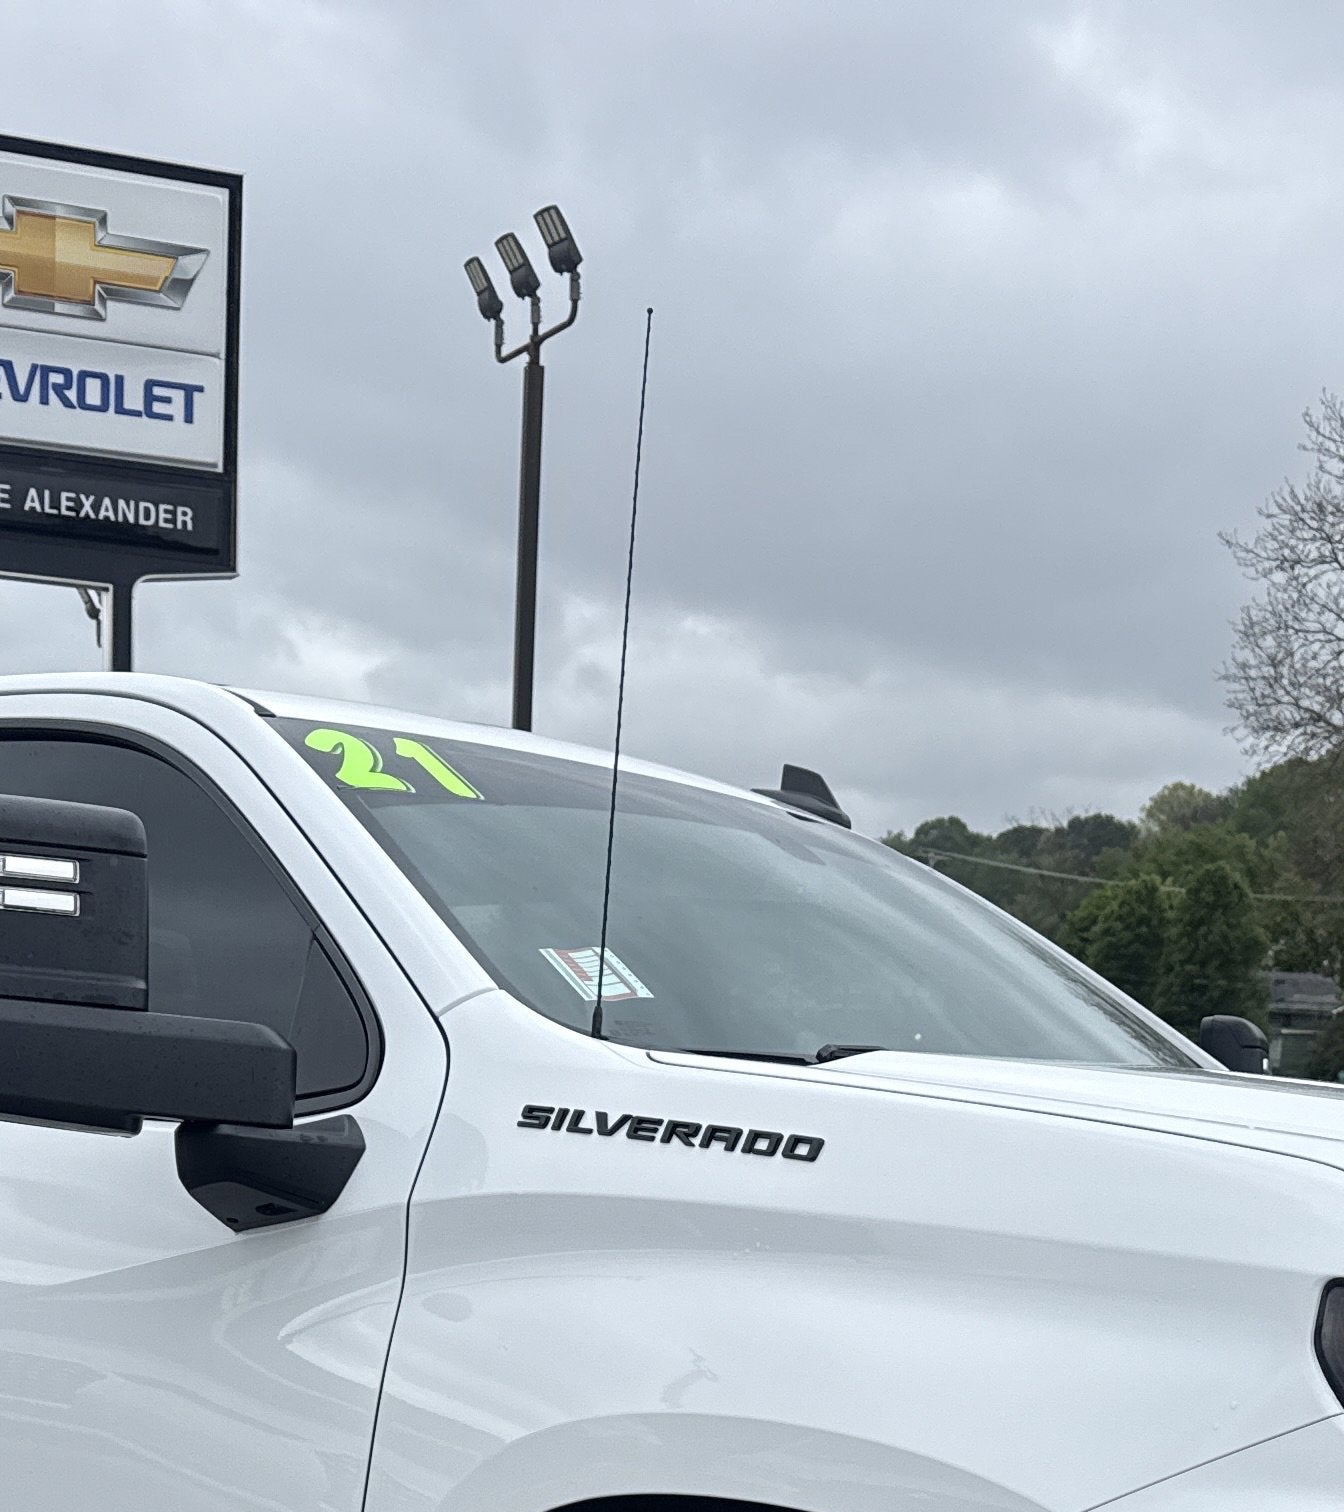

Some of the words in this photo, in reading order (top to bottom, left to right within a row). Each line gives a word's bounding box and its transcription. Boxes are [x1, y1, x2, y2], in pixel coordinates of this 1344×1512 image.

[23, 487, 194, 531] ALEXANDER
[305, 728, 484, 800] 21
[517, 1104, 825, 1162] SILVERADO
